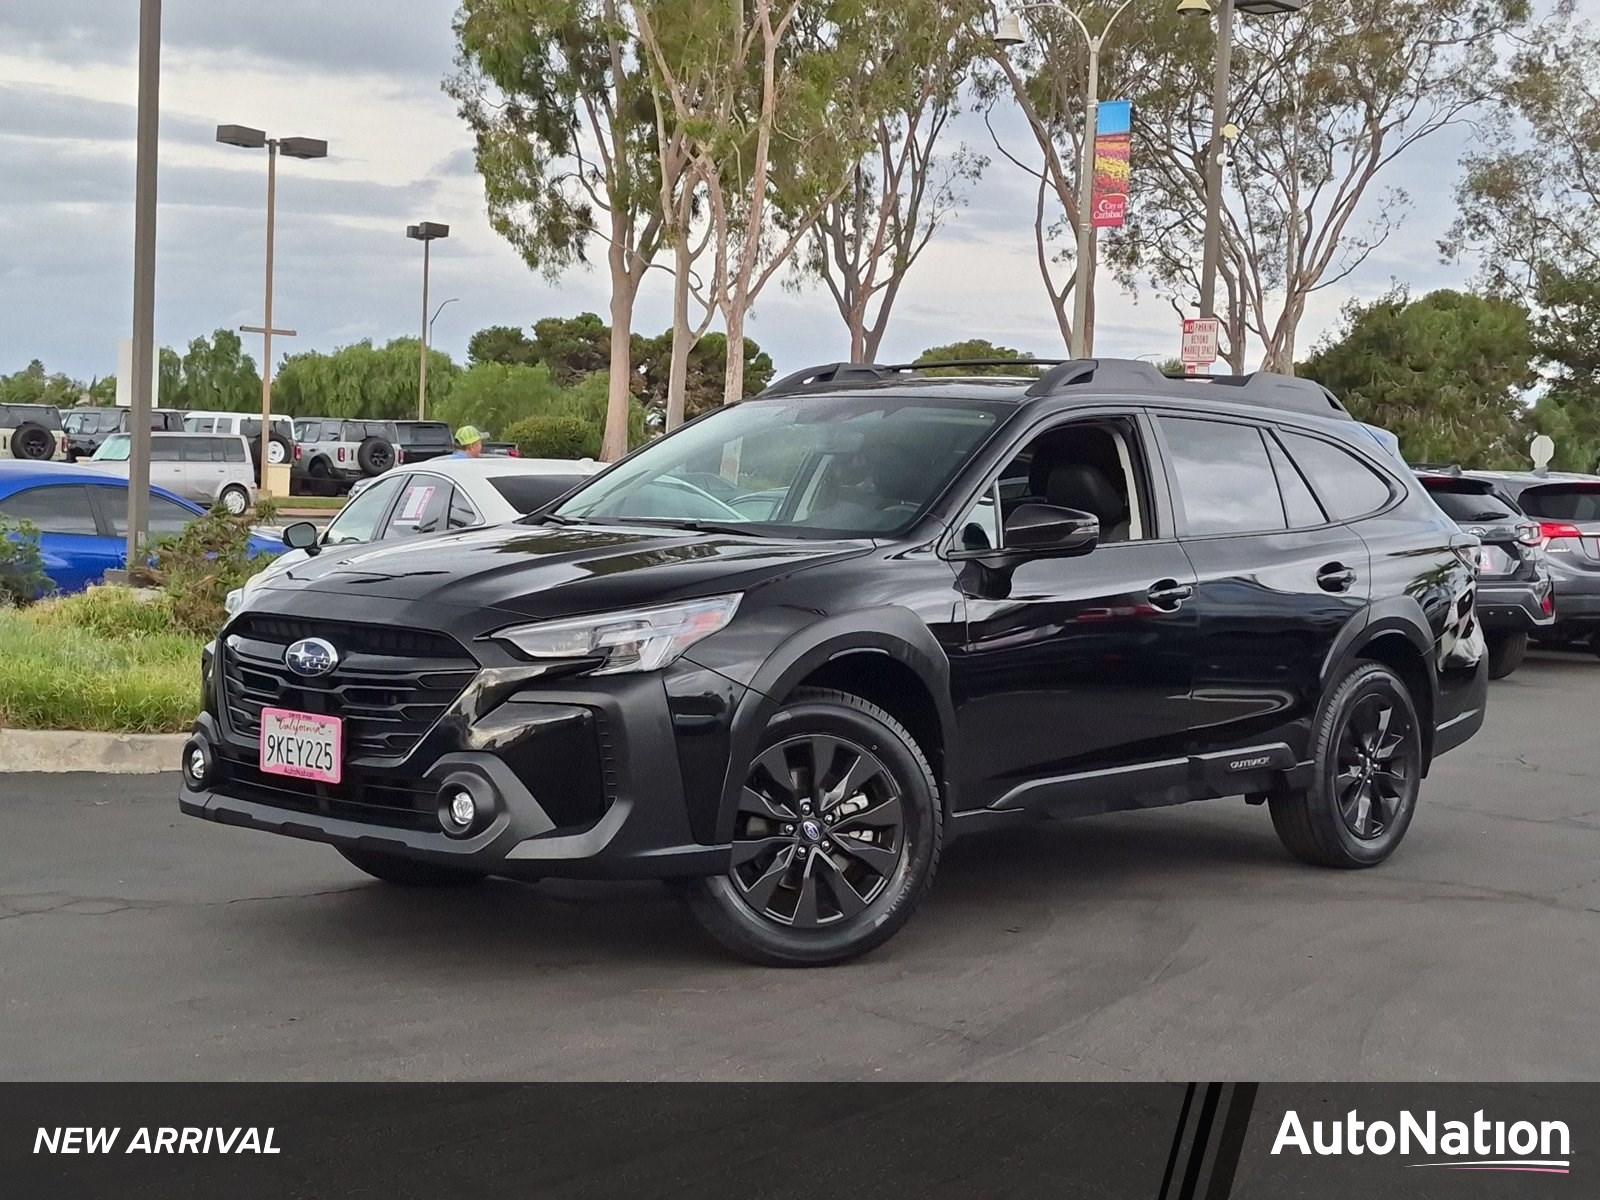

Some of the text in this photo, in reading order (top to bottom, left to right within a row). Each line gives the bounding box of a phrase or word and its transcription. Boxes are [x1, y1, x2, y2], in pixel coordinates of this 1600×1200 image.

[1093, 209, 1124, 219] Carlsbad
[1185, 322, 1216, 332] NO PARKING
[278, 717, 322, 735] California
[267, 734, 333, 771] 9KEY225
